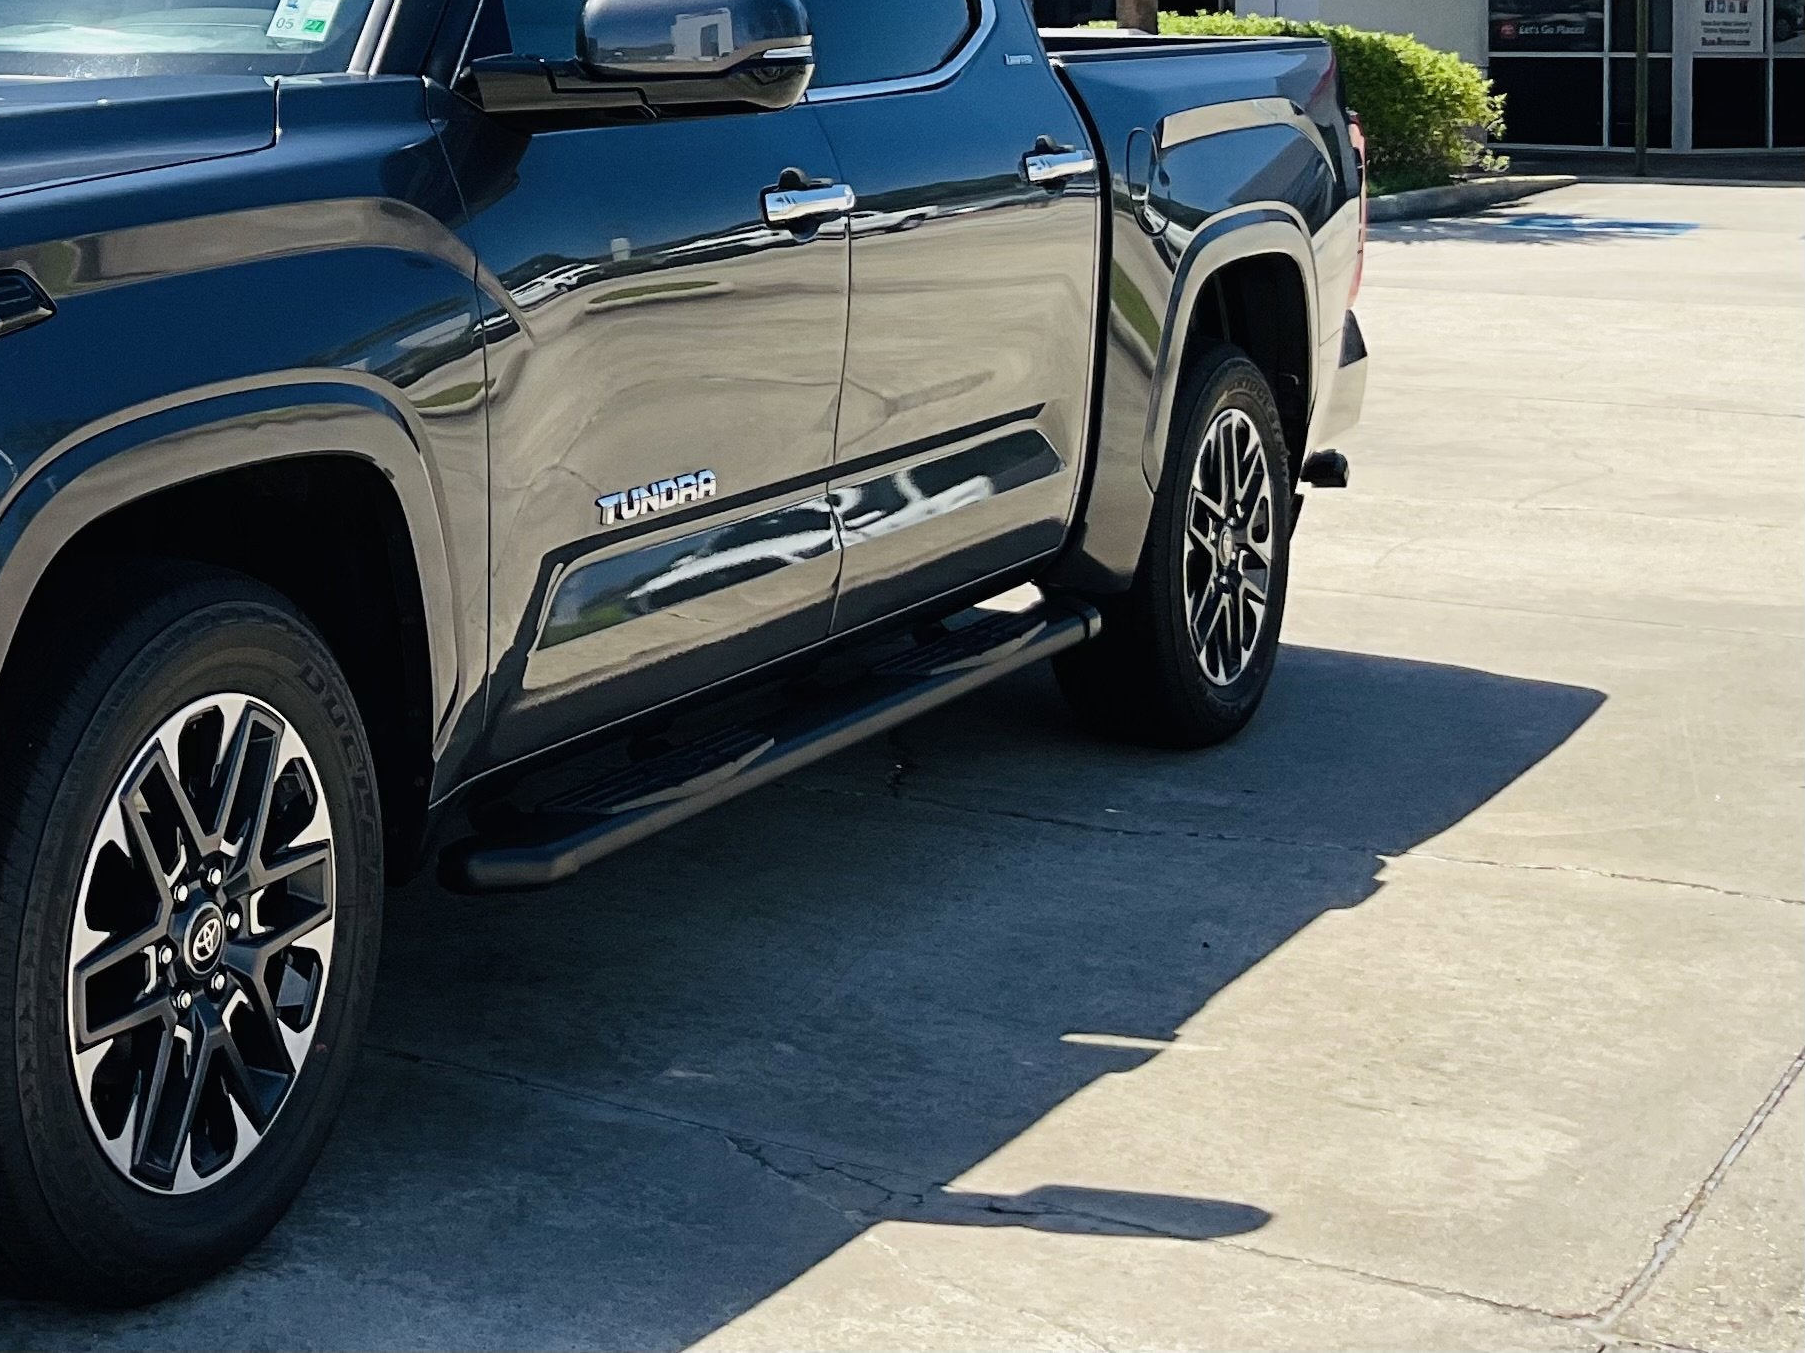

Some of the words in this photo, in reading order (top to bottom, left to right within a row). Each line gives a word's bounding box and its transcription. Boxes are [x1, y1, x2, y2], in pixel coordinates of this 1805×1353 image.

[276, 18, 294, 29] 05
[305, 19, 325, 31] 27
[595, 469, 717, 525] TUNDRA
